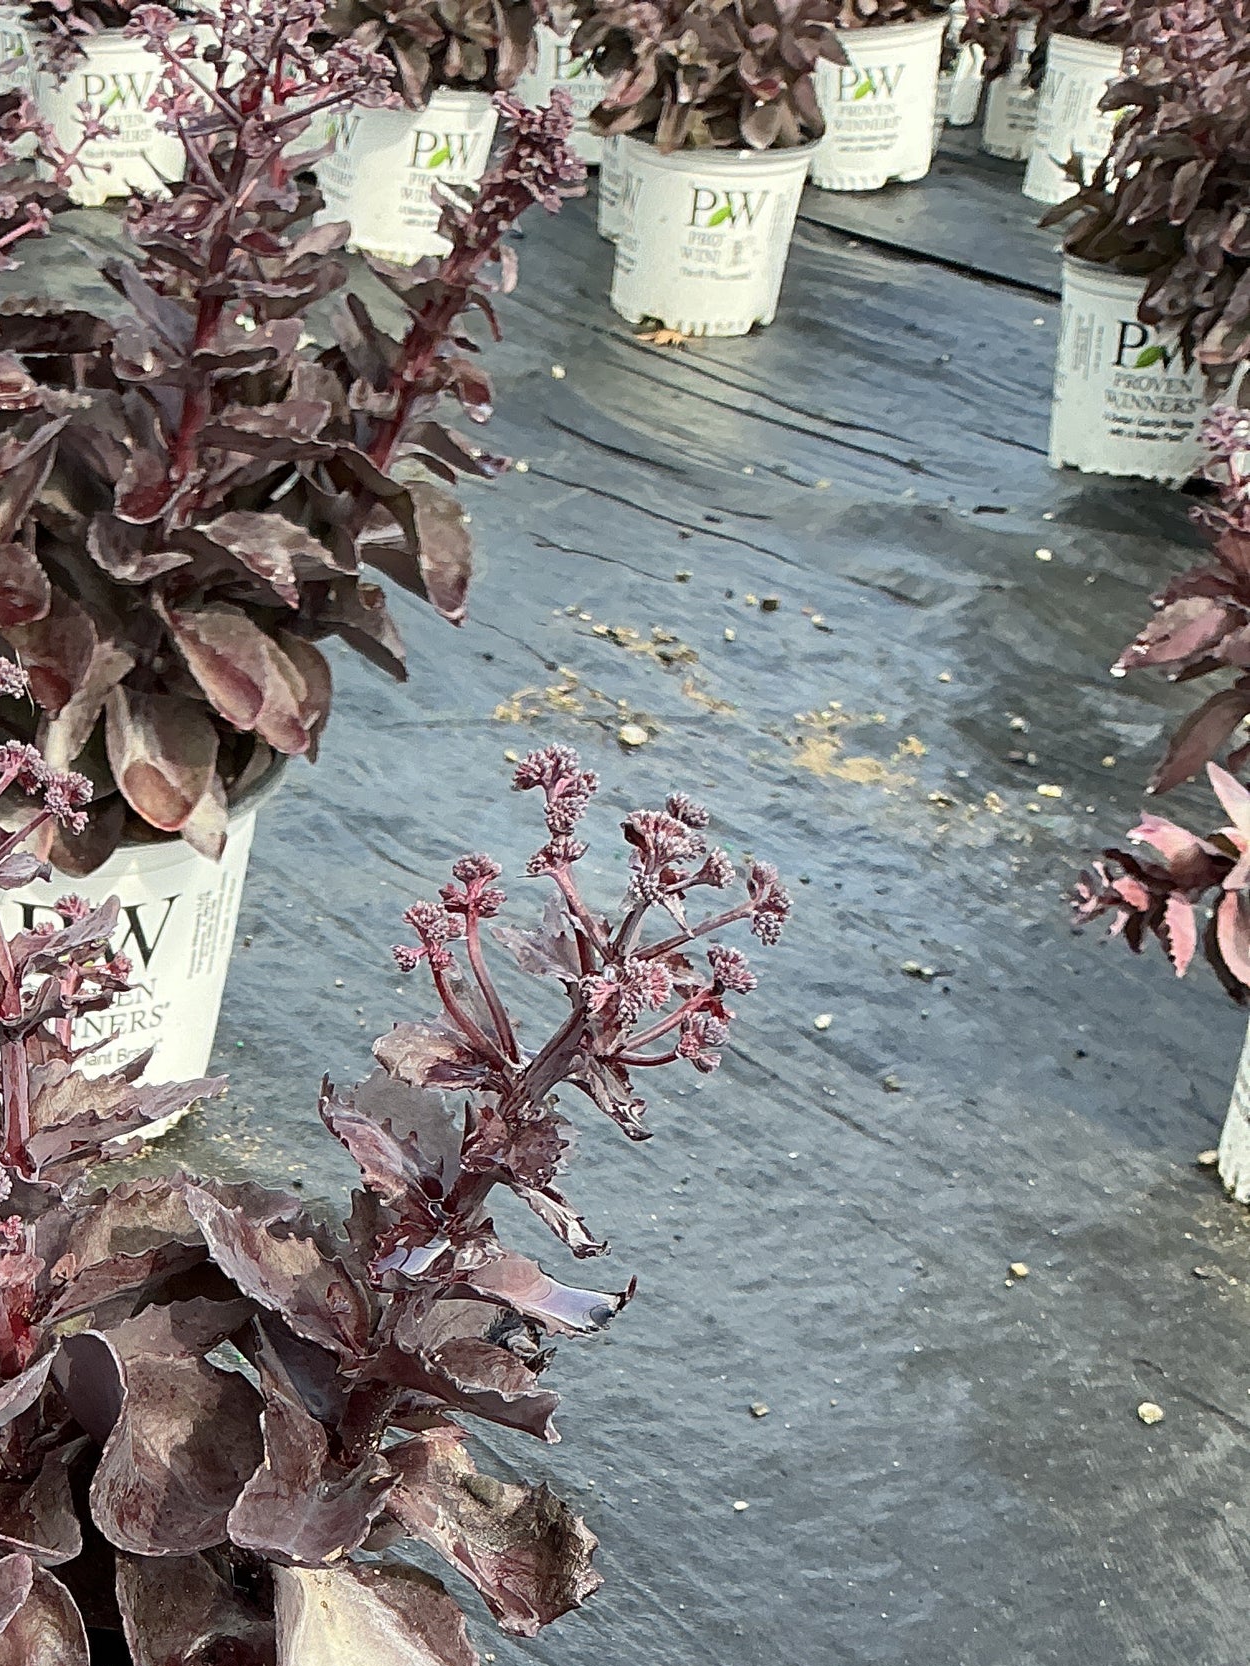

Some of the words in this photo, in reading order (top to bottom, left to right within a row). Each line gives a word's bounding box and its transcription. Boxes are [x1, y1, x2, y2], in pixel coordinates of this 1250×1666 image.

[80, 71, 154, 107] PW
[834, 63, 906, 102] PW
[405, 129, 484, 169] PW
[685, 185, 771, 229] PW
